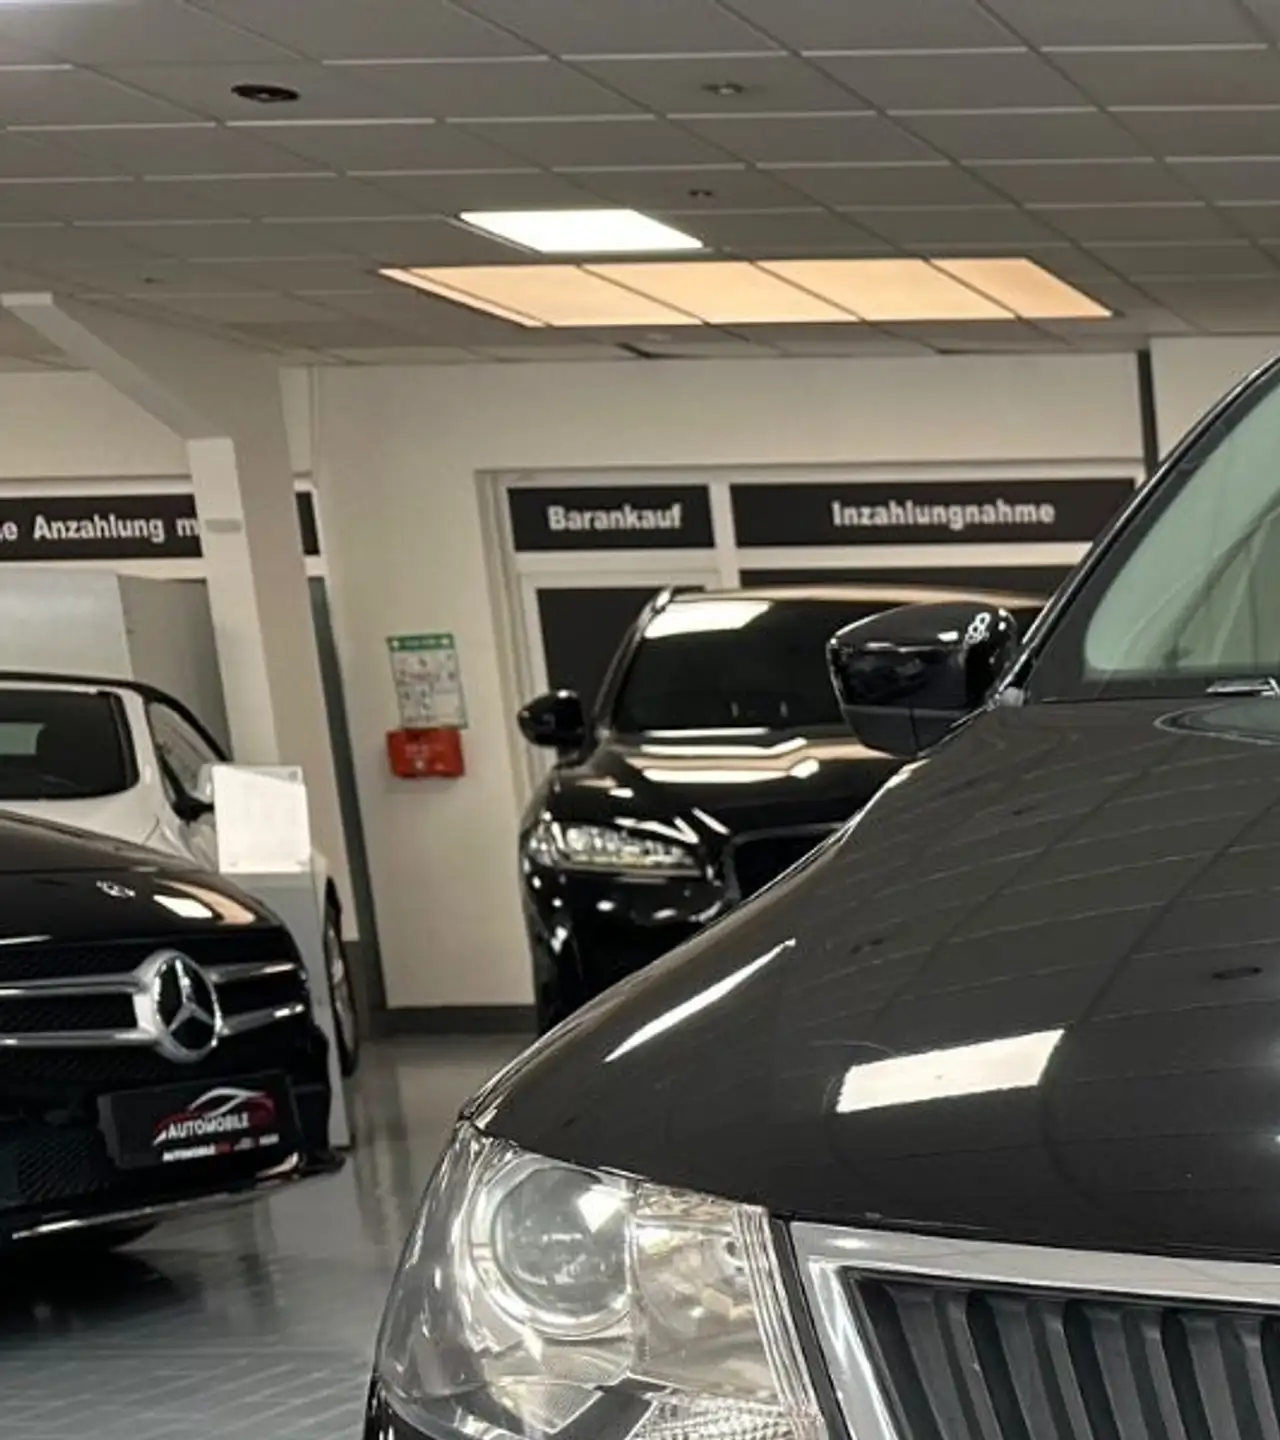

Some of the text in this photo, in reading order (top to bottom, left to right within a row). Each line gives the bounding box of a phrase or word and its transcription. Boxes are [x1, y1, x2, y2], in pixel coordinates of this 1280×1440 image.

[33, 512, 166, 544] Anzahlung
[546, 502, 682, 531] Barankauf
[831, 498, 1056, 532] Inzahlungnahme
